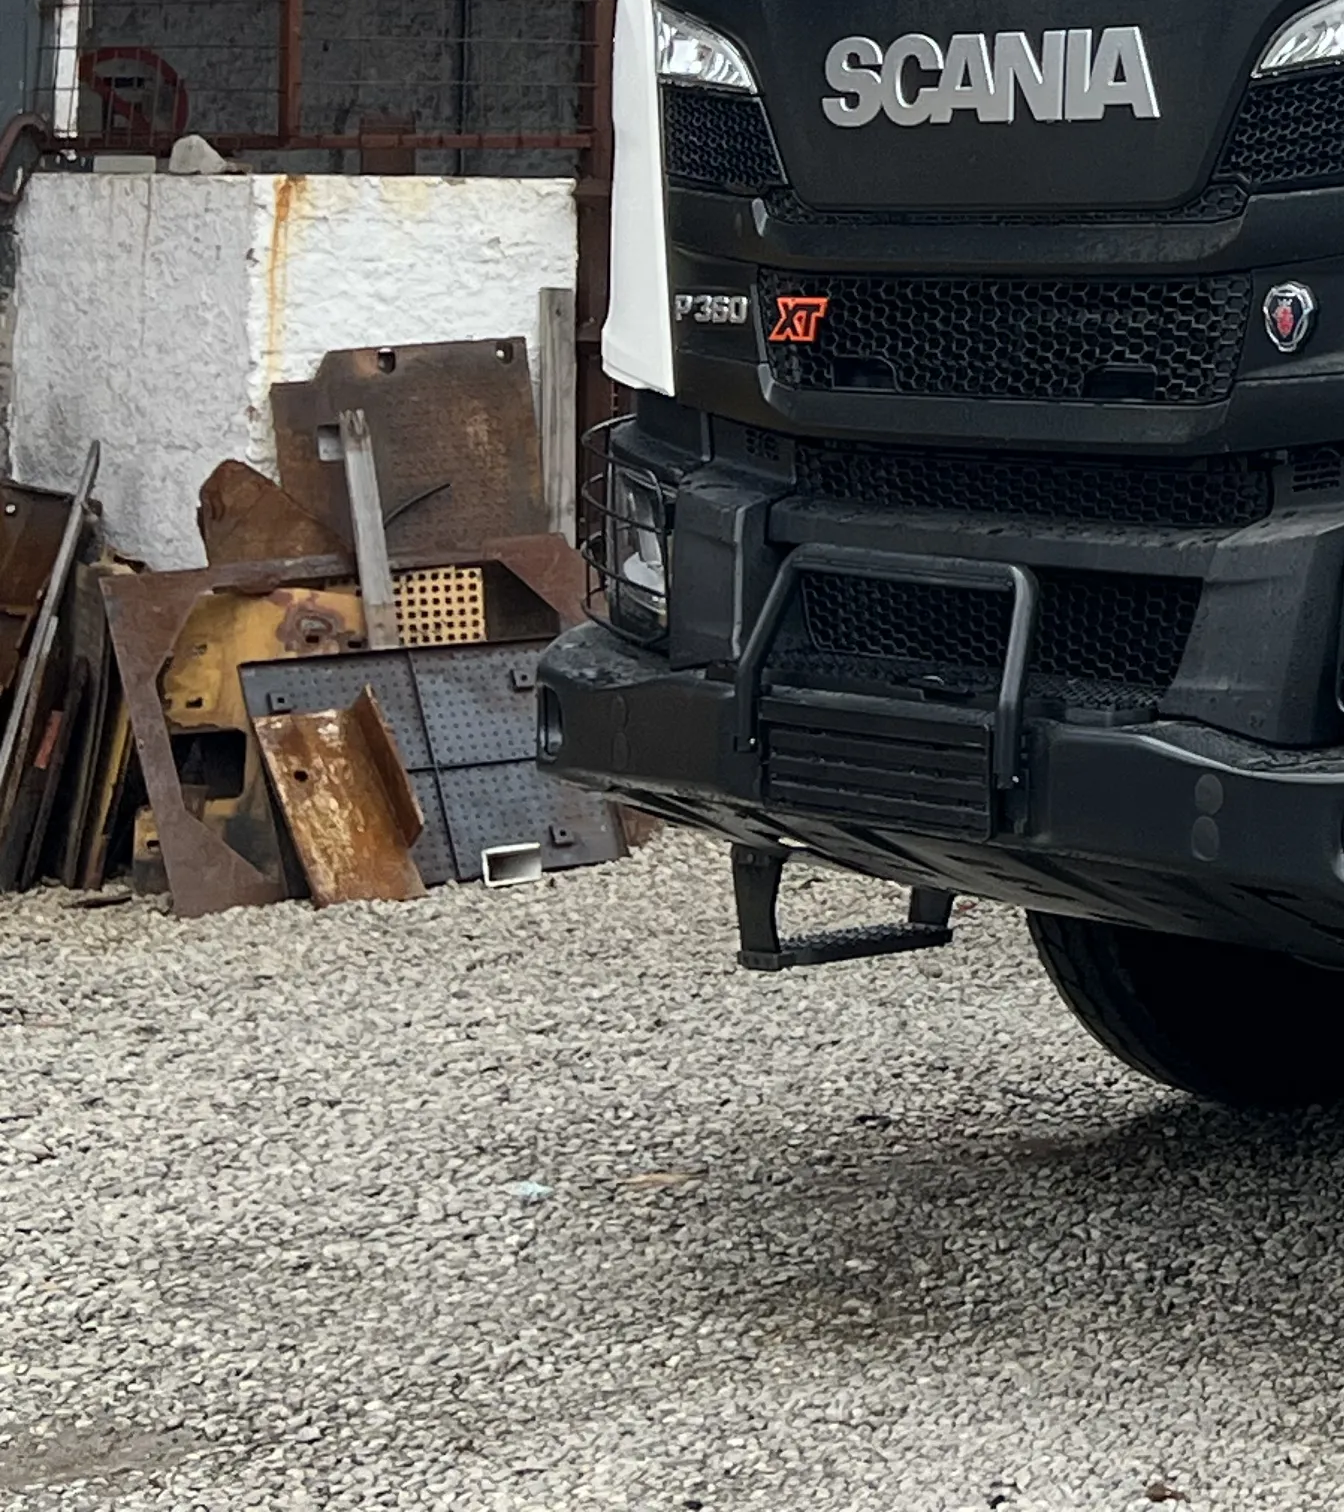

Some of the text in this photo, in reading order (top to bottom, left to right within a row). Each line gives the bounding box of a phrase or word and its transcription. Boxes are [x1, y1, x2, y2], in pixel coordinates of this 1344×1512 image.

[821, 25, 1161, 128] SCANIA
[674, 294, 748, 324] P 360
[768, 297, 829, 342] XT
